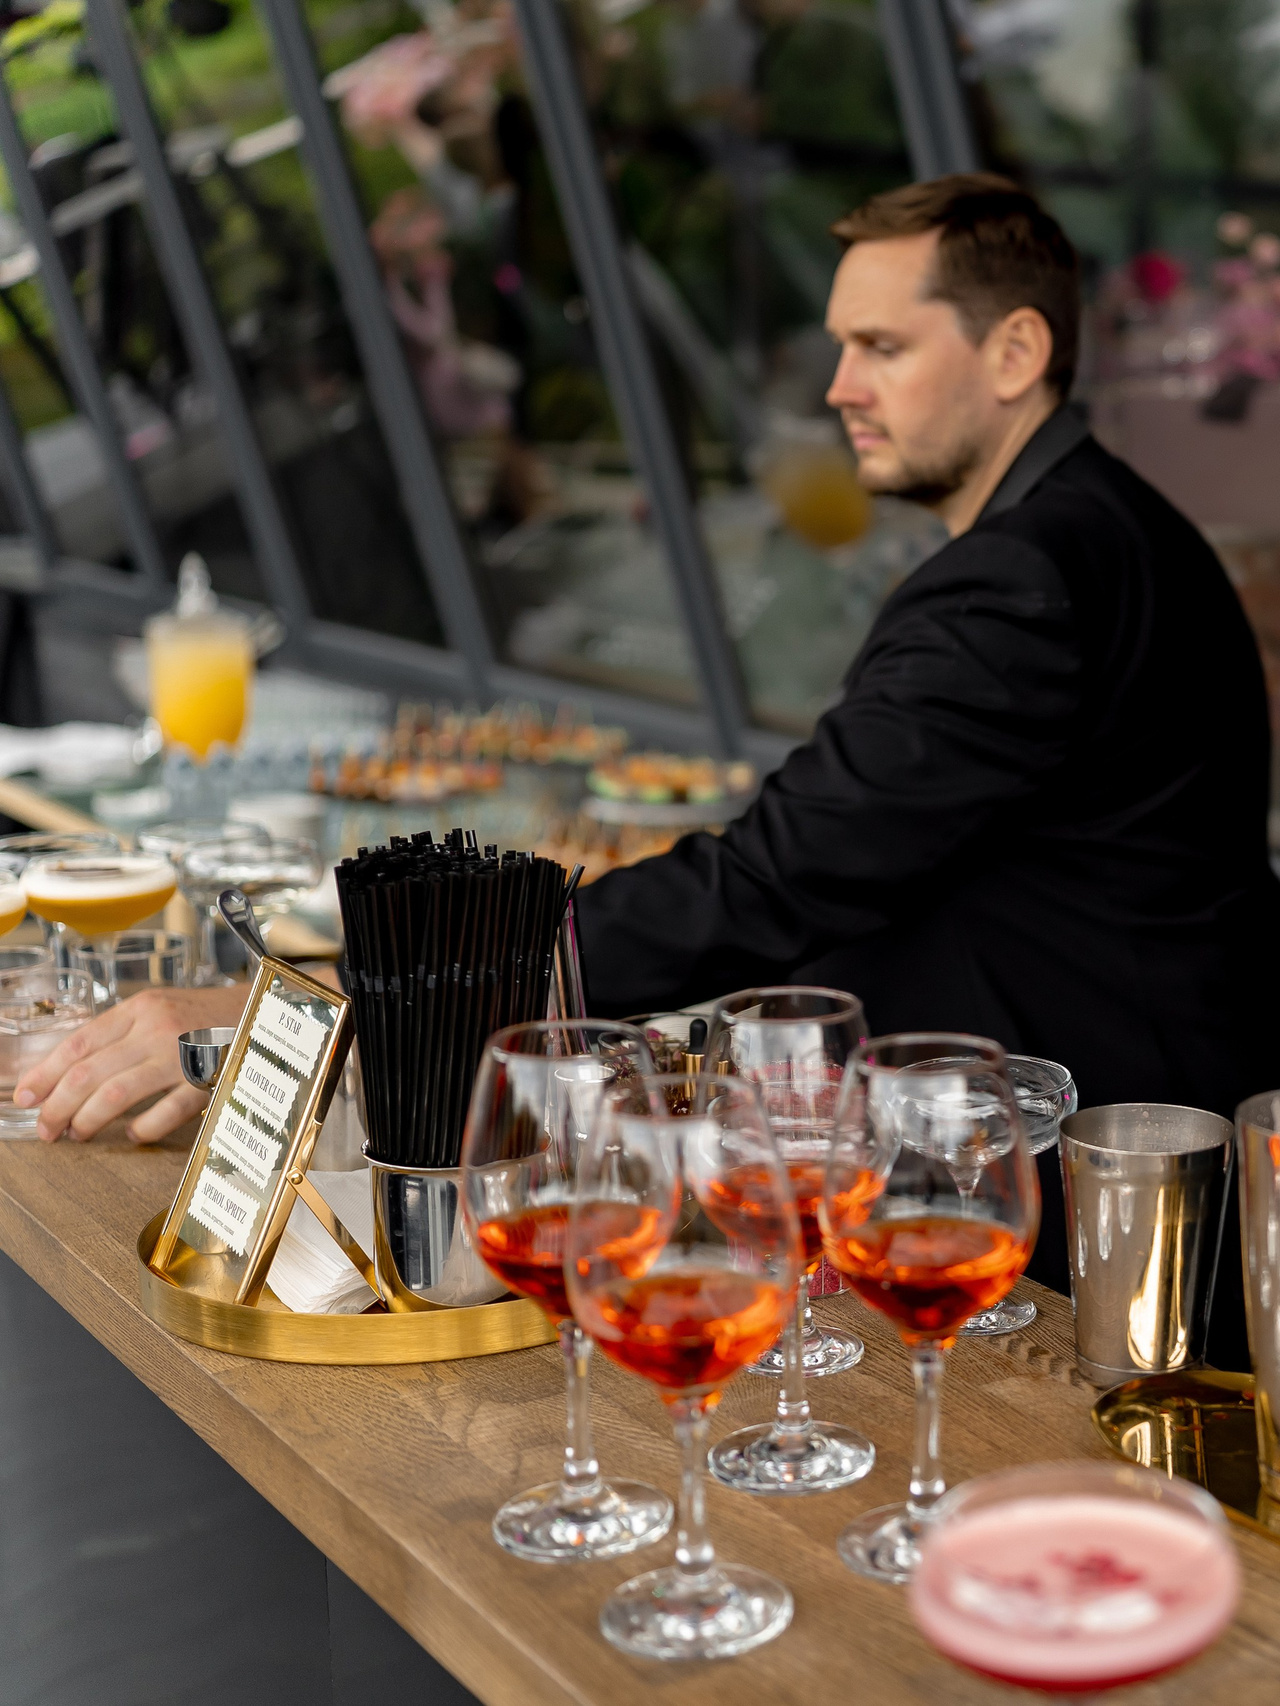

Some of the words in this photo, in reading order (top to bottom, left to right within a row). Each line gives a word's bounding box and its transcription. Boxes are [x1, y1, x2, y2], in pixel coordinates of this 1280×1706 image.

[285, 1016, 302, 1036] STAR
[245, 1066, 269, 1092] CLOVER
[268, 1084, 286, 1104] CLUB
[224, 1118, 248, 1145] LYCHEE
[246, 1136, 268, 1161] ROCKS
[202, 1182, 224, 1208] APEROL
[224, 1198, 248, 1224] SPRITZ
